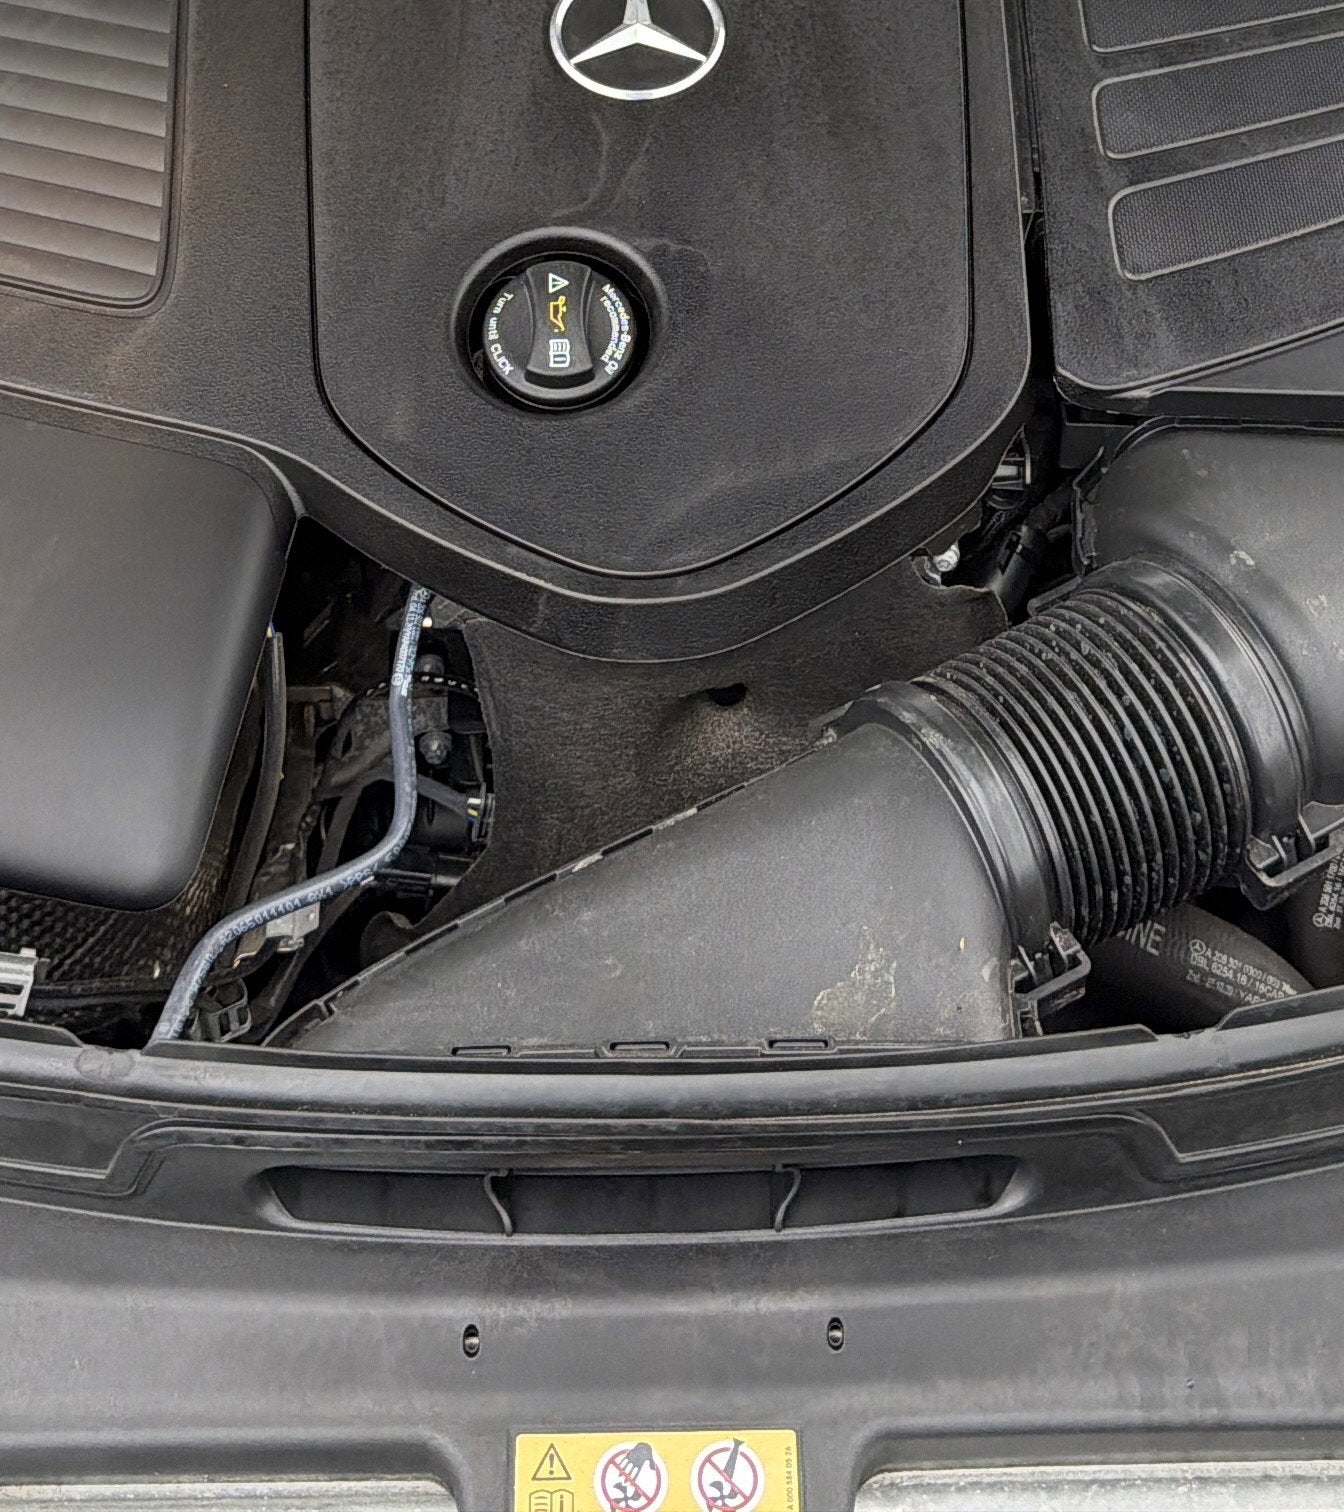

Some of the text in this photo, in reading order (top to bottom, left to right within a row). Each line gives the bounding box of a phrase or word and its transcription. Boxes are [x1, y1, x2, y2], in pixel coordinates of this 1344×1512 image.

[488, 292, 514, 376] Turn until CLICK
[600, 296, 620, 363] recommended
[601, 283, 631, 375] Mercedes-Benz Oil
[1117, 920, 1166, 956] INE
